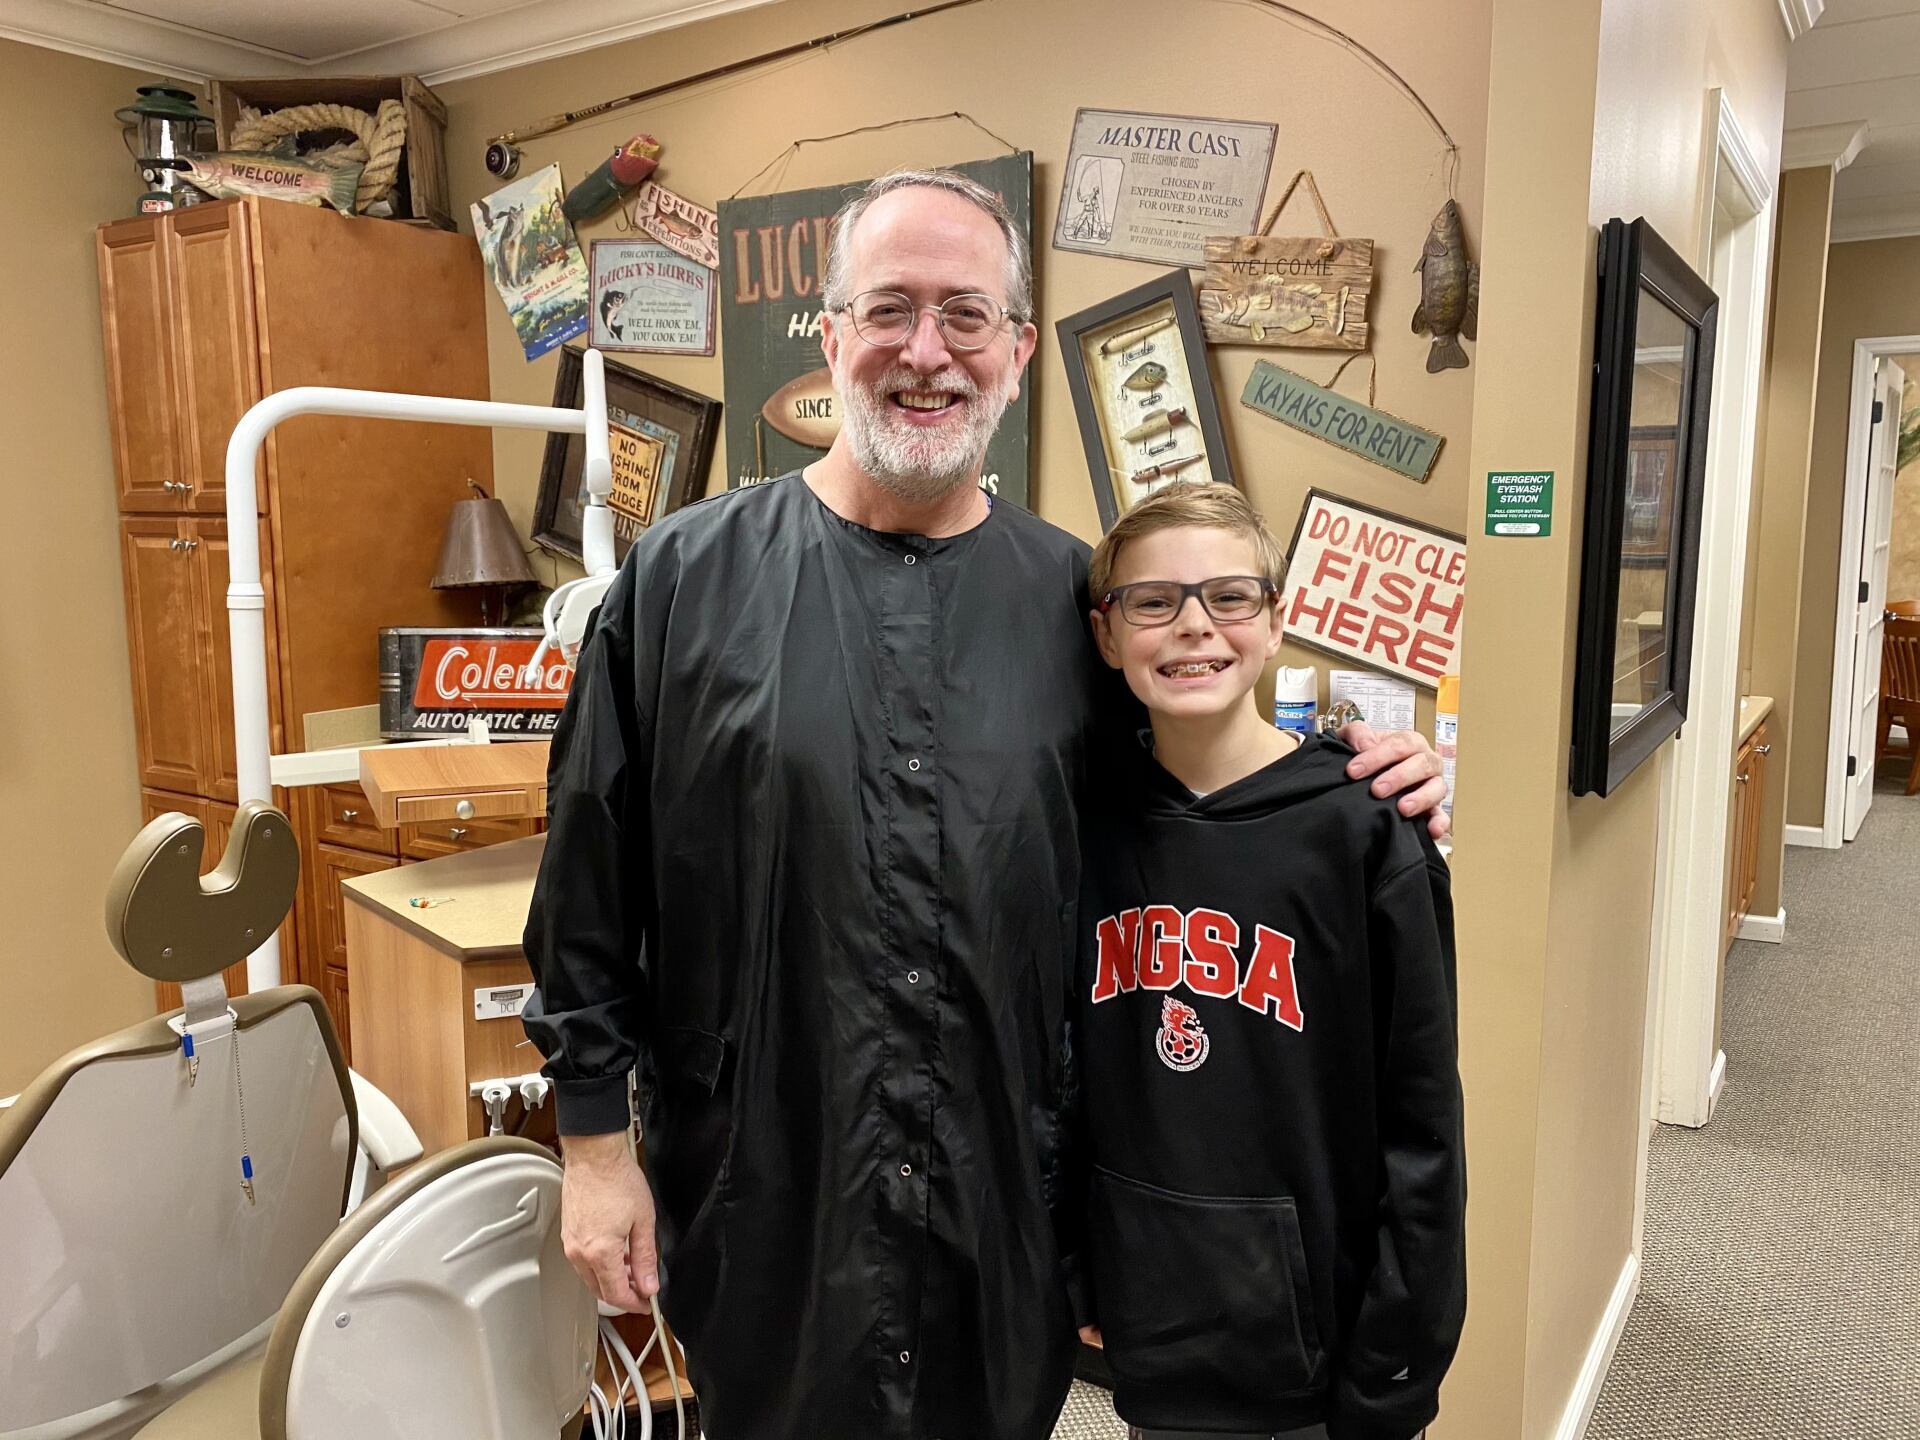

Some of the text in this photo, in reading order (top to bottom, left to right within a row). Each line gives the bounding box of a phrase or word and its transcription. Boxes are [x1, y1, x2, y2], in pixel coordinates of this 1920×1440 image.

[1096, 127, 1241, 157] MASTER CAST
[1131, 152, 1200, 169] STEEL FISHING RODS
[231, 163, 303, 187] WELCOME
[1161, 177, 1216, 191] CHOSEN BY
[1130, 186, 1244, 207] EXPERIENCED ANGLERS
[1138, 200, 1230, 219] FOR OVER 50 YEARS
[647, 222, 702, 257] EXPEDITIONS
[1130, 235, 1148, 244] WITH
[1150, 237, 1173, 248] THEIR
[1141, 226, 1164, 236] THINK
[1166, 228, 1182, 237] YOU
[620, 250, 635, 258] FISH
[599, 262, 704, 291] LUCKY'S LURES
[1231, 258, 1335, 276] WELCOME
[628, 318, 653, 328] WE'LL
[655, 318, 681, 329] HOOK
[632, 331, 697, 343] YOU COOK 'EM!
[796, 397, 833, 419] SINCE
[1253, 375, 1426, 466] KAYAKS FOR RENT
[619, 438, 637, 457] NO
[610, 453, 651, 479] ISHING
[1491, 475, 1551, 484] EMERGENCY
[1497, 485, 1543, 494] EYEWASH
[609, 488, 643, 512] RIDGE
[1500, 495, 1539, 503] STATION
[1308, 507, 1350, 546] DO
[1352, 522, 1416, 566] NOT
[1311, 548, 1464, 634] FISH
[1287, 586, 1455, 679] HERE
[435, 646, 568, 700] Colema
[412, 712, 525, 730] AUTOMATIC
[1091, 905, 1304, 1032] NGSA
